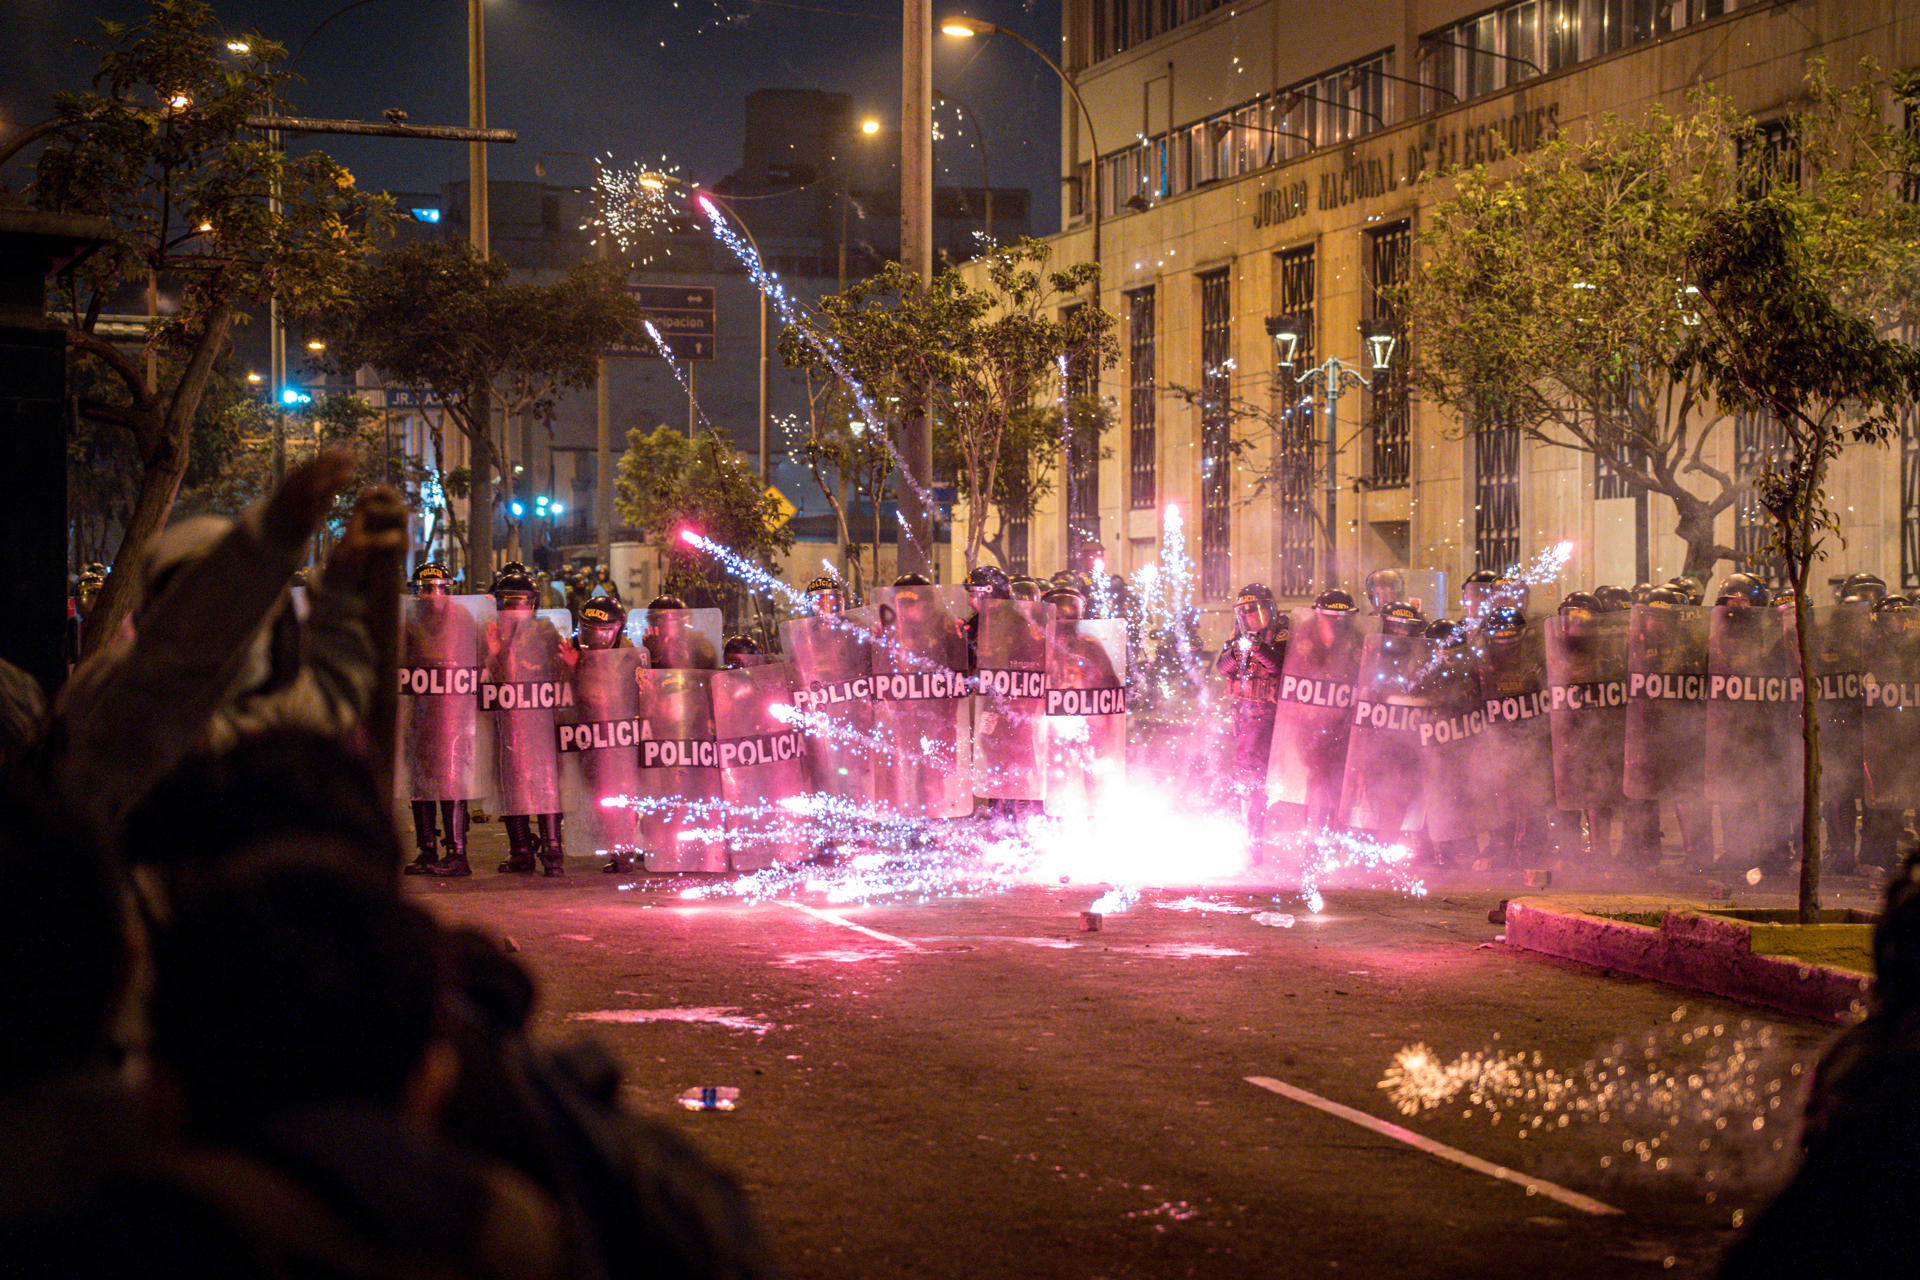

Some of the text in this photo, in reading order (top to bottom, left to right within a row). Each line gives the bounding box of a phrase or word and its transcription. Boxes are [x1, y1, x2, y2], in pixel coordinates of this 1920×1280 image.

[1253, 179, 1308, 229] JURADO
[1318, 149, 1397, 210] NACIONAL
[809, 579, 833, 591] POLICIA
[483, 681, 574, 709] POLICIA
[793, 677, 874, 710] POLICI
[876, 672, 967, 699] POLICIA
[1551, 681, 1628, 710] POLICI
[1630, 673, 1706, 700] POLICI
[1711, 675, 1787, 702] POLICI
[1866, 682, 1920, 707] POLI
[1048, 687, 1125, 715] POLICIA
[1486, 689, 1551, 723] POLIC
[560, 719, 653, 751] POLICIA
[1420, 709, 1487, 746] POLICI
[644, 741, 718, 767] POLICI
[720, 732, 807, 769] POLICIA
